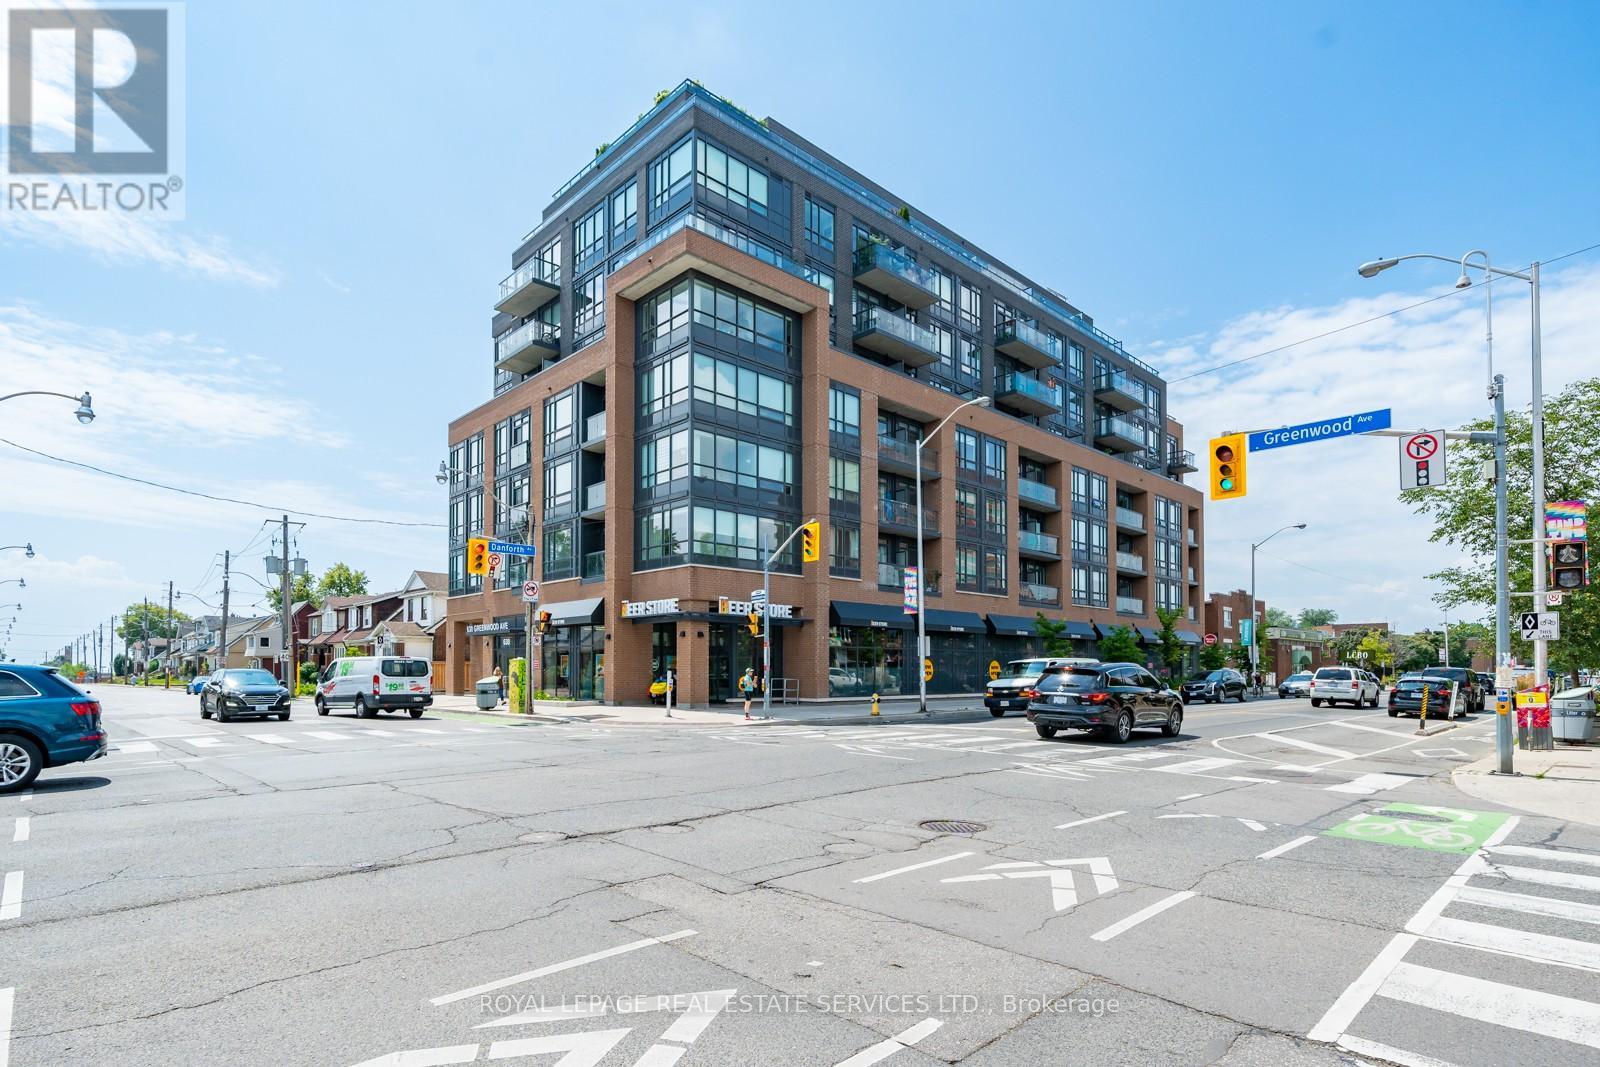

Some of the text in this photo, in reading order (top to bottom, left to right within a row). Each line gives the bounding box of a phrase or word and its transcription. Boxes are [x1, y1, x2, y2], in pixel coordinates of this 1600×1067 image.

[1264, 415, 1373, 445] Greenwood Ave
[491, 543, 525, 553] Danforth
[645, 598, 680, 615] STORE
[719, 596, 753, 616] BEER
[753, 602, 793, 619] SORE
[473, 623, 499, 632] GREENWOOD
[500, 622, 509, 630] AVE
[1346, 651, 1368, 659] LCBO
